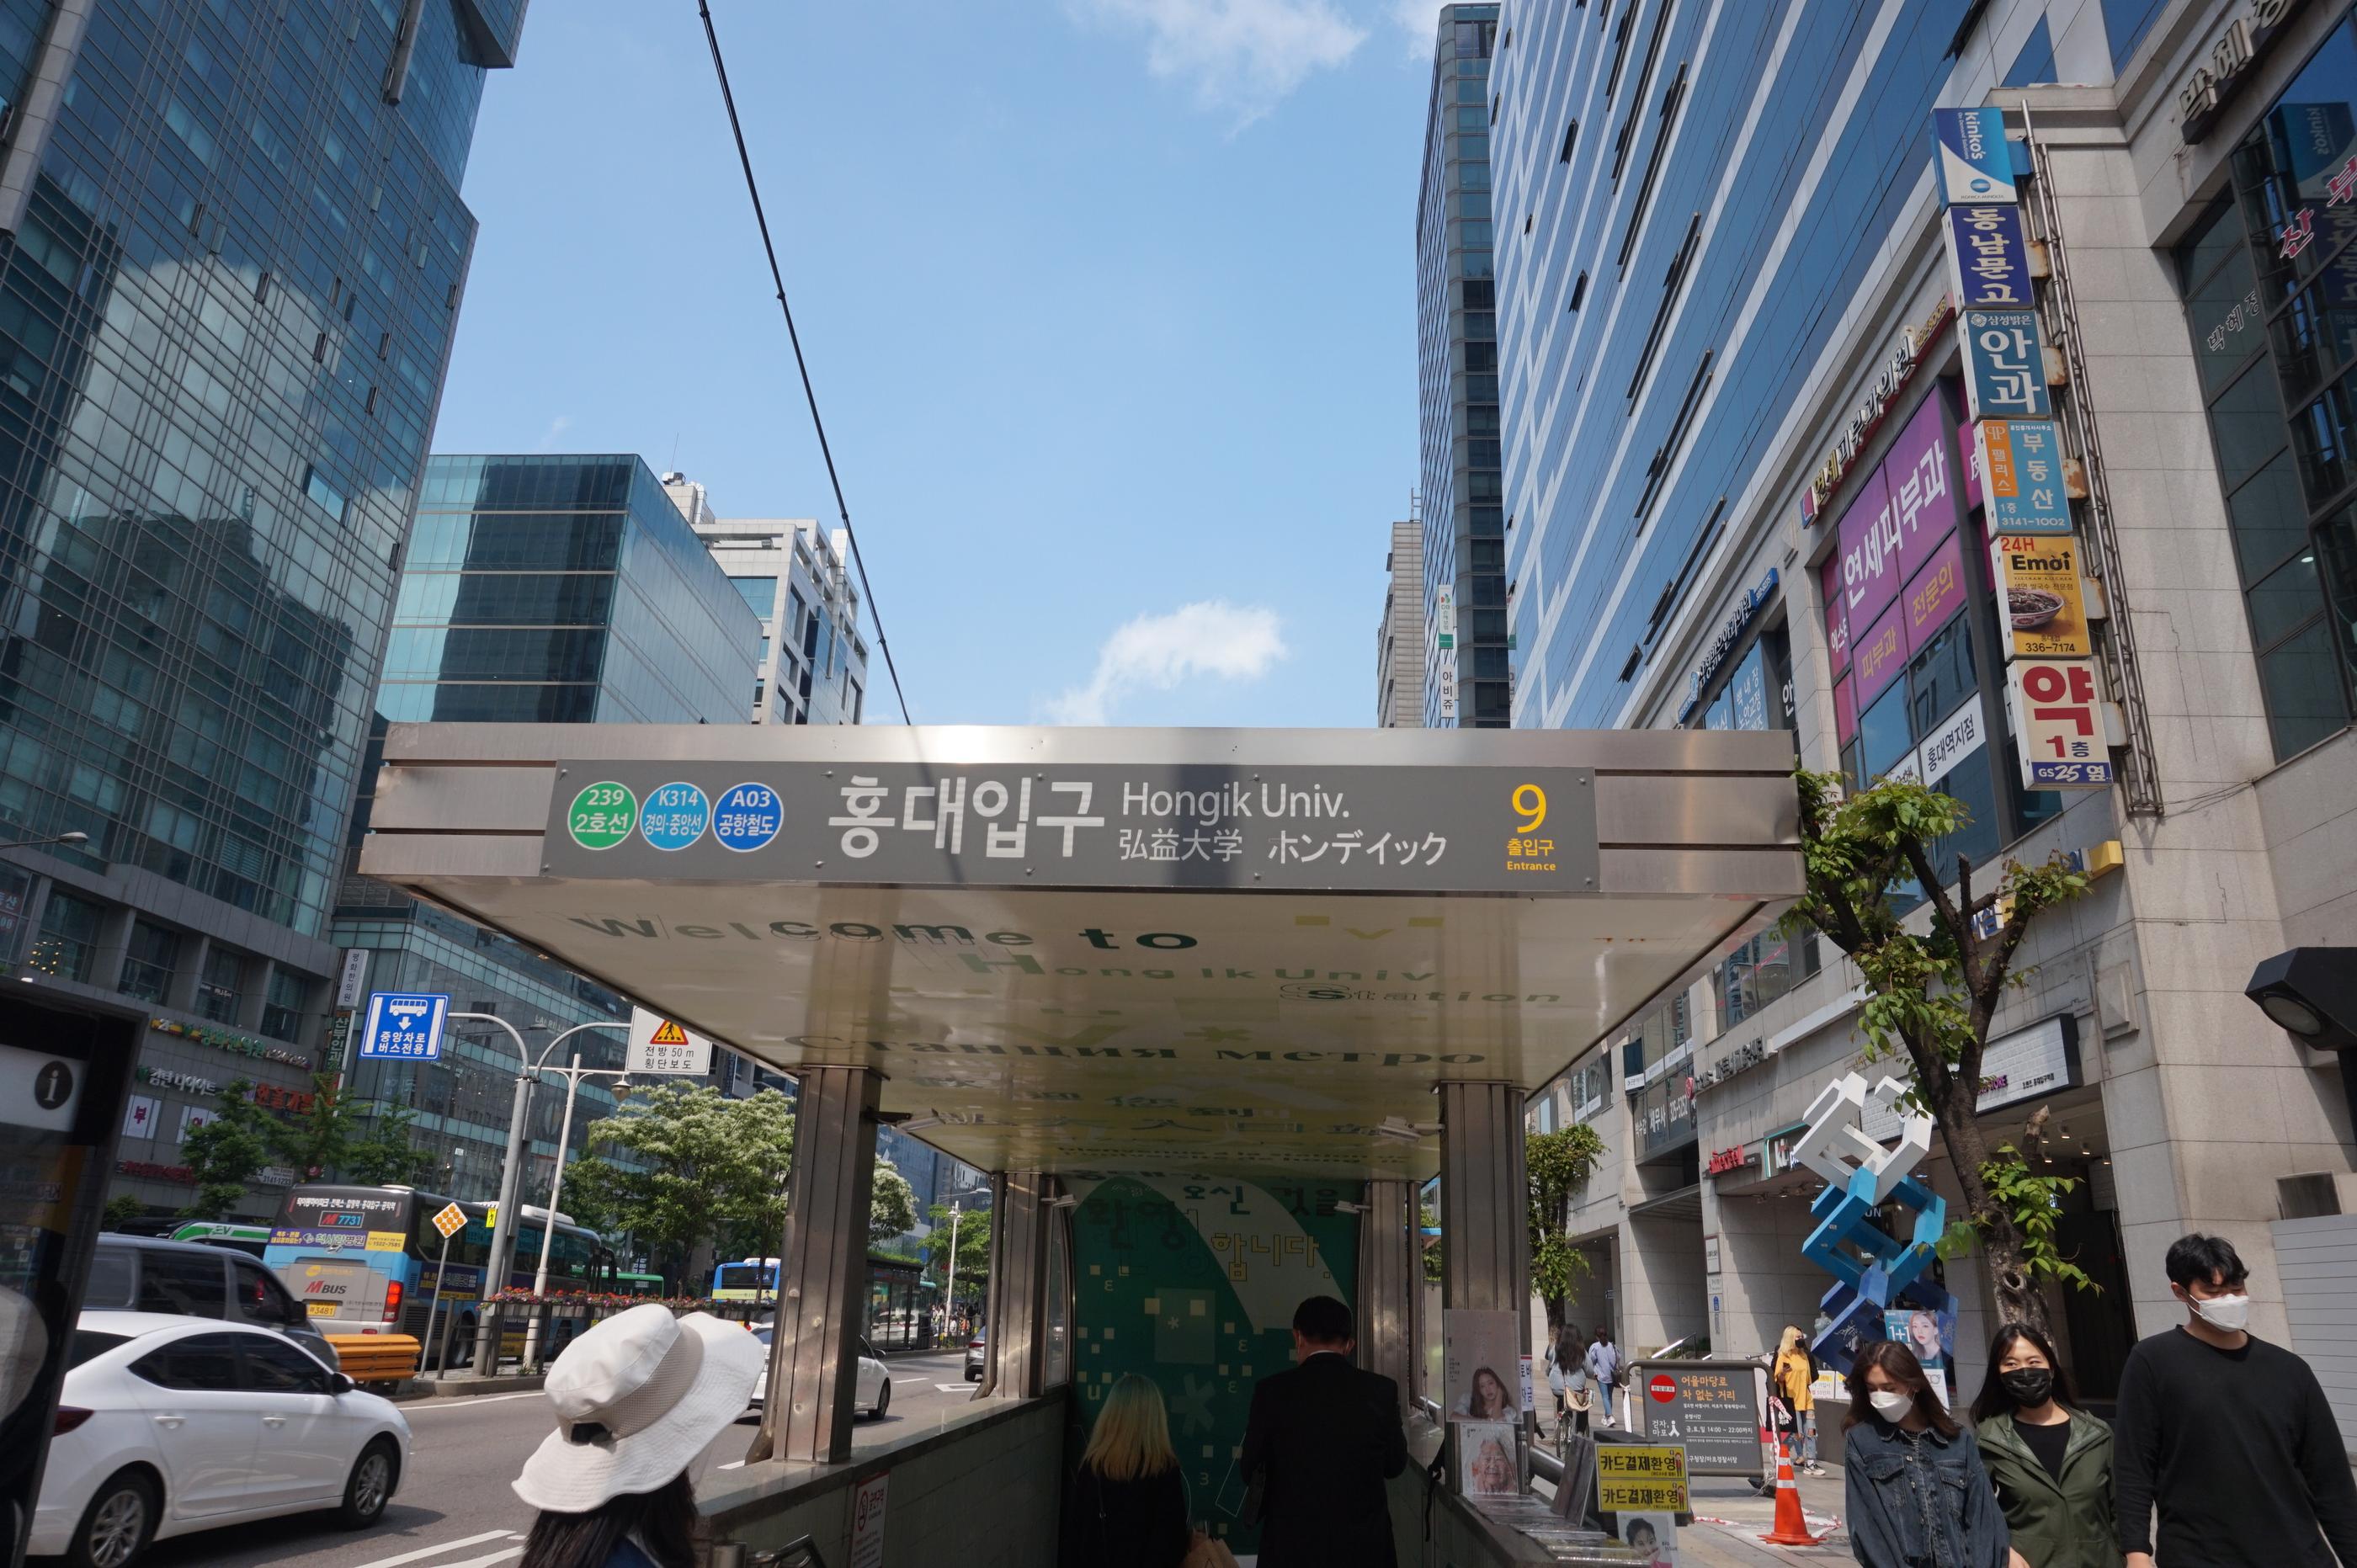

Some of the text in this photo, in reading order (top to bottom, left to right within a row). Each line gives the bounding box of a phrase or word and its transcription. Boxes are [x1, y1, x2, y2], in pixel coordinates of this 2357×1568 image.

[1965, 112, 1986, 160] kinko's
[1963, 207, 2019, 304] 동남문고
[1987, 314, 2033, 327] 삼성밝은
[1980, 328, 2041, 414] 안과
[1814, 335, 1917, 505] 연세피부과의원
[2023, 433, 2054, 510] 부동산
[2000, 502, 2017, 513] 1층
[1845, 439, 1946, 610] 연세피부과
[2002, 518, 2065, 526] 3141-1002
[2000, 537, 2035, 551] 24H
[1912, 561, 1955, 627] 전문의
[1861, 625, 1897, 680] 피부과
[2025, 643, 2076, 652] 336-7174
[1442, 671, 1454, 710] 아비쥬
[2023, 666, 2094, 736] 약
[1928, 714, 1975, 772] 홍대역지점
[2046, 736, 2090, 758] 1층
[2038, 764, 2083, 783] GS25
[587, 789, 625, 807] 239
[658, 789, 699, 808] K314
[730, 789, 772, 808] A03
[1121, 781, 1350, 827] Hongik Univ.
[1512, 784, 1547, 833] 9
[574, 812, 630, 837] 2호선
[718, 812, 775, 837] 공항철도
[828, 775, 1105, 859] 홍대입구
[1119, 827, 1243, 864] 弘益大学
[1506, 838, 1555, 858] 출입구
[1507, 860, 1556, 872] Entrance
[569, 915, 1199, 950] Welcome to
[380, 1030, 426, 1044] 중앙차로
[378, 1042, 424, 1055] 버스전용
[644, 1046, 668, 1059] 전방
[671, 1047, 684, 1057] 50
[784, 1034, 1486, 1067] Станция метро
[644, 1057, 692, 1071] 횡단보도
[1184, 1185, 1252, 1215] 오신
[1681, 1375, 1728, 1388] 어울마당로
[1695, 1390, 1715, 1401] 없는
[1718, 1390, 1736, 1401] 거리
[1652, 1428, 1668, 1438] 마포
[1600, 1455, 1676, 1471] 카드결제환영
[1686, 1455, 1737, 1464] 구청장/마포경찰서장
[1603, 1488, 1679, 1505] 카드결제환영
